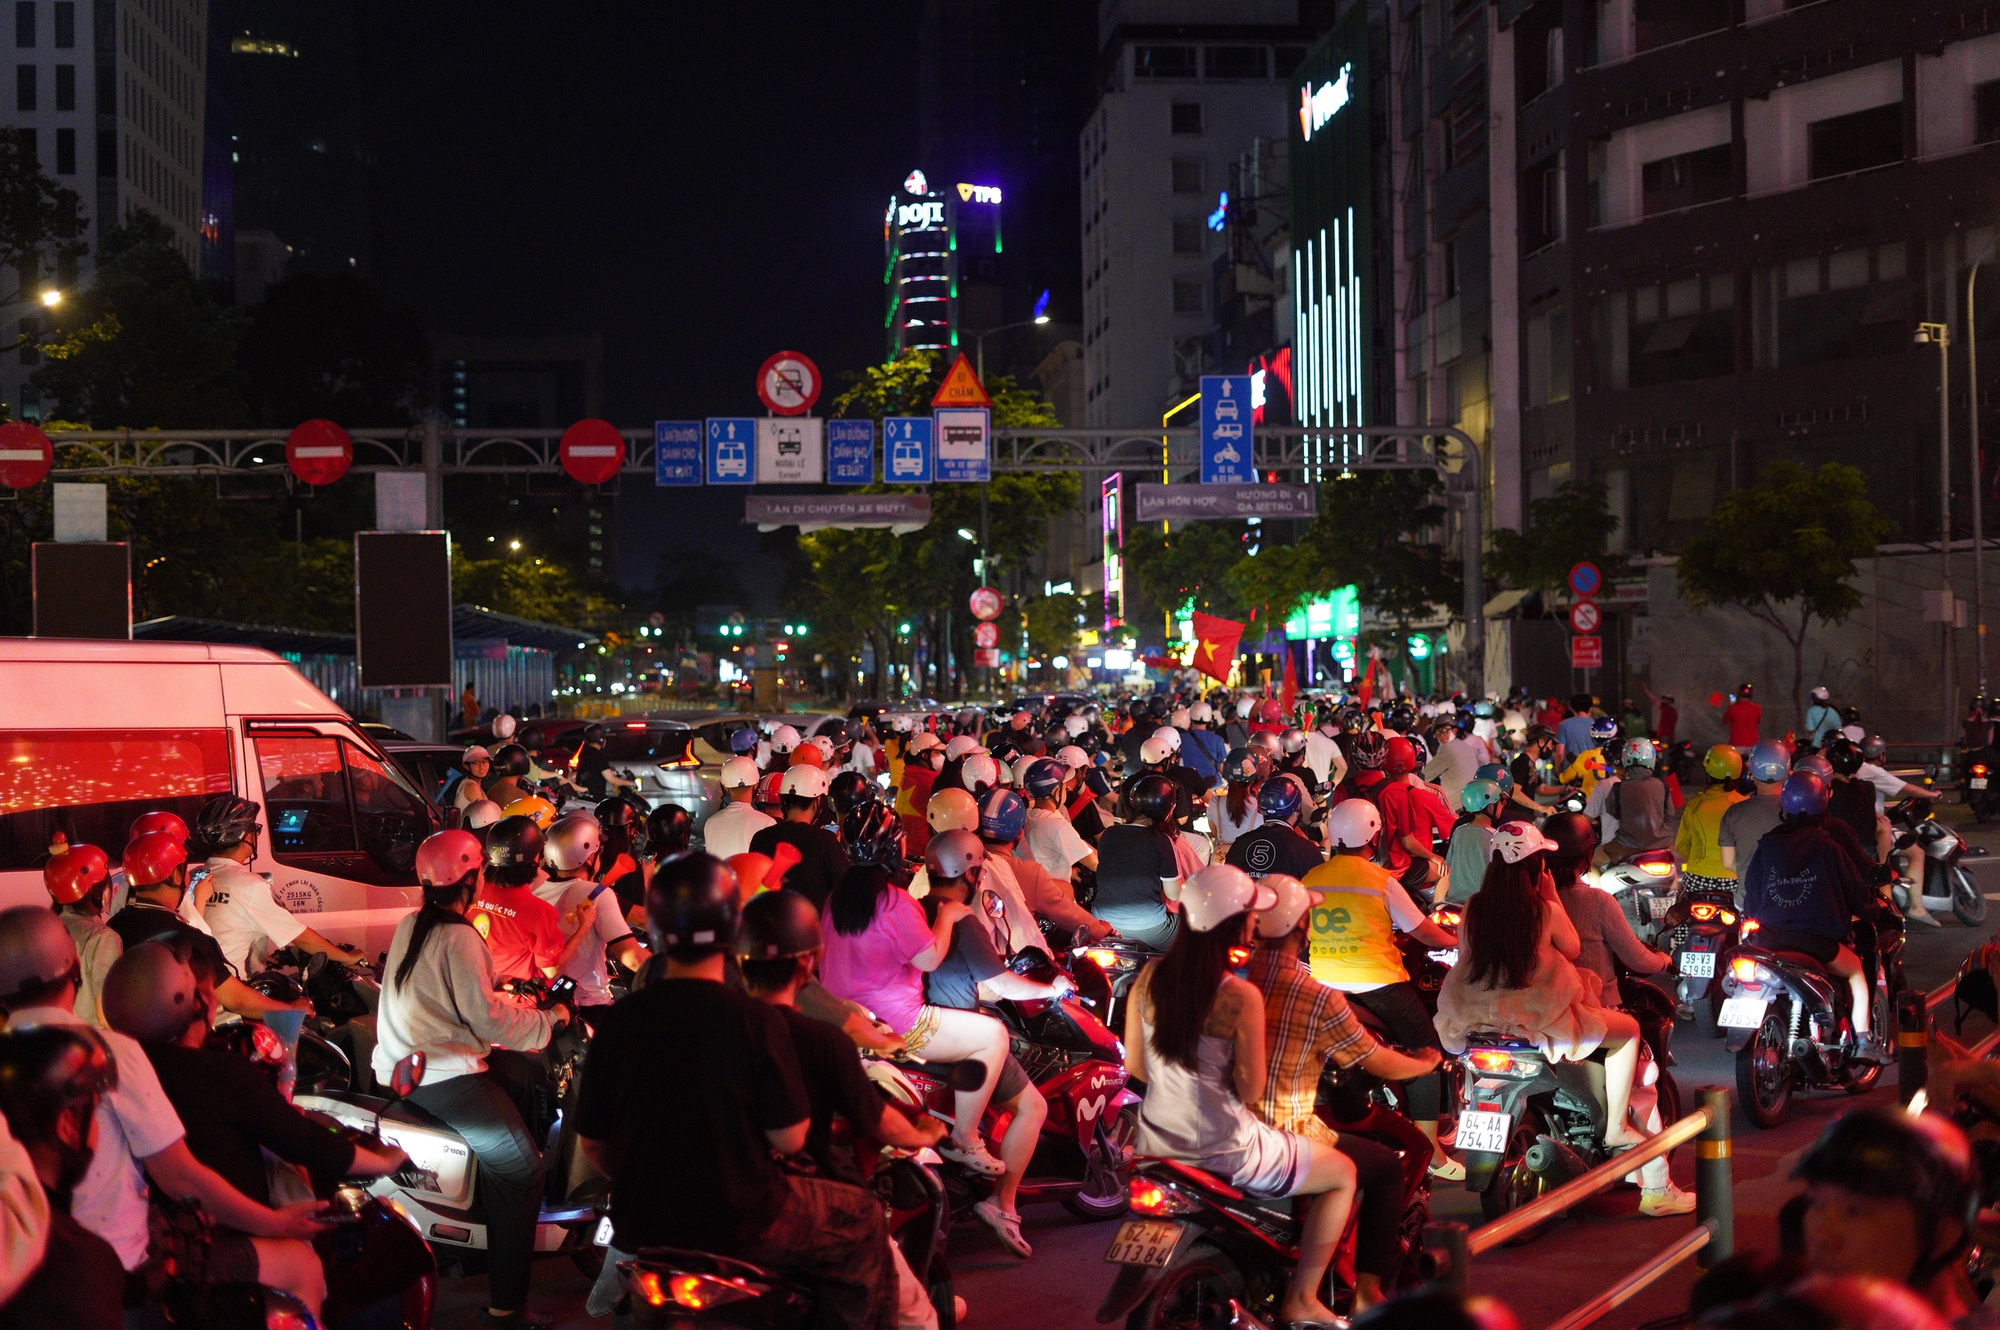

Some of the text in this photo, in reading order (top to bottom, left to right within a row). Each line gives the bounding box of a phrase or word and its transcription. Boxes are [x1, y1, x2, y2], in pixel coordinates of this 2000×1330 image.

[1251, 844, 1269, 865] 5
[1312, 906, 1351, 934] be
[1685, 953, 1711, 964] 59-V3
[1465, 1113, 1502, 1132] 64-AA
[1459, 1131, 1503, 1150] 754.12
[1124, 1223, 1173, 1245] 62-AF
